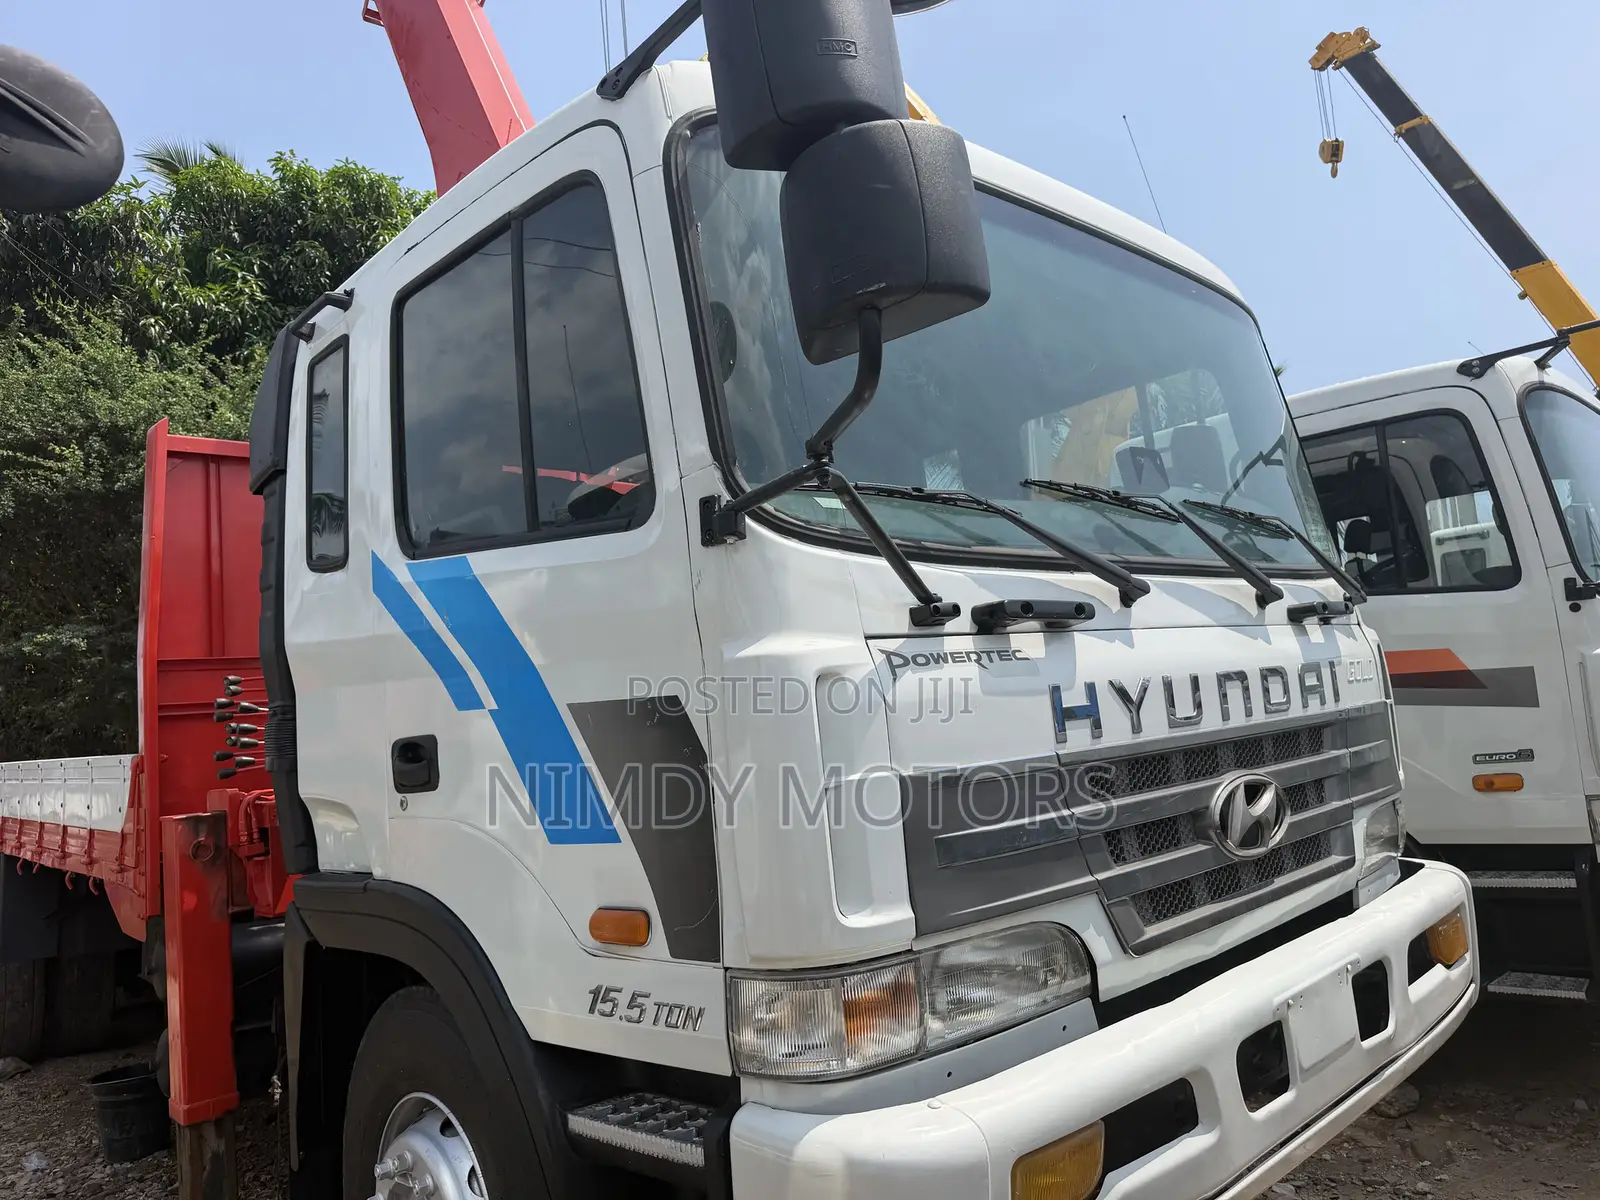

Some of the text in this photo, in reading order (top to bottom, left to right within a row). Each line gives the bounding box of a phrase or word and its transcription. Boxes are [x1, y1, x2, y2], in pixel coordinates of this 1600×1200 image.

[877, 648, 1031, 682] POWERTEC
[1048, 660, 1341, 744] HYUNDAI
[588, 984, 706, 1031] 15.5 TON
